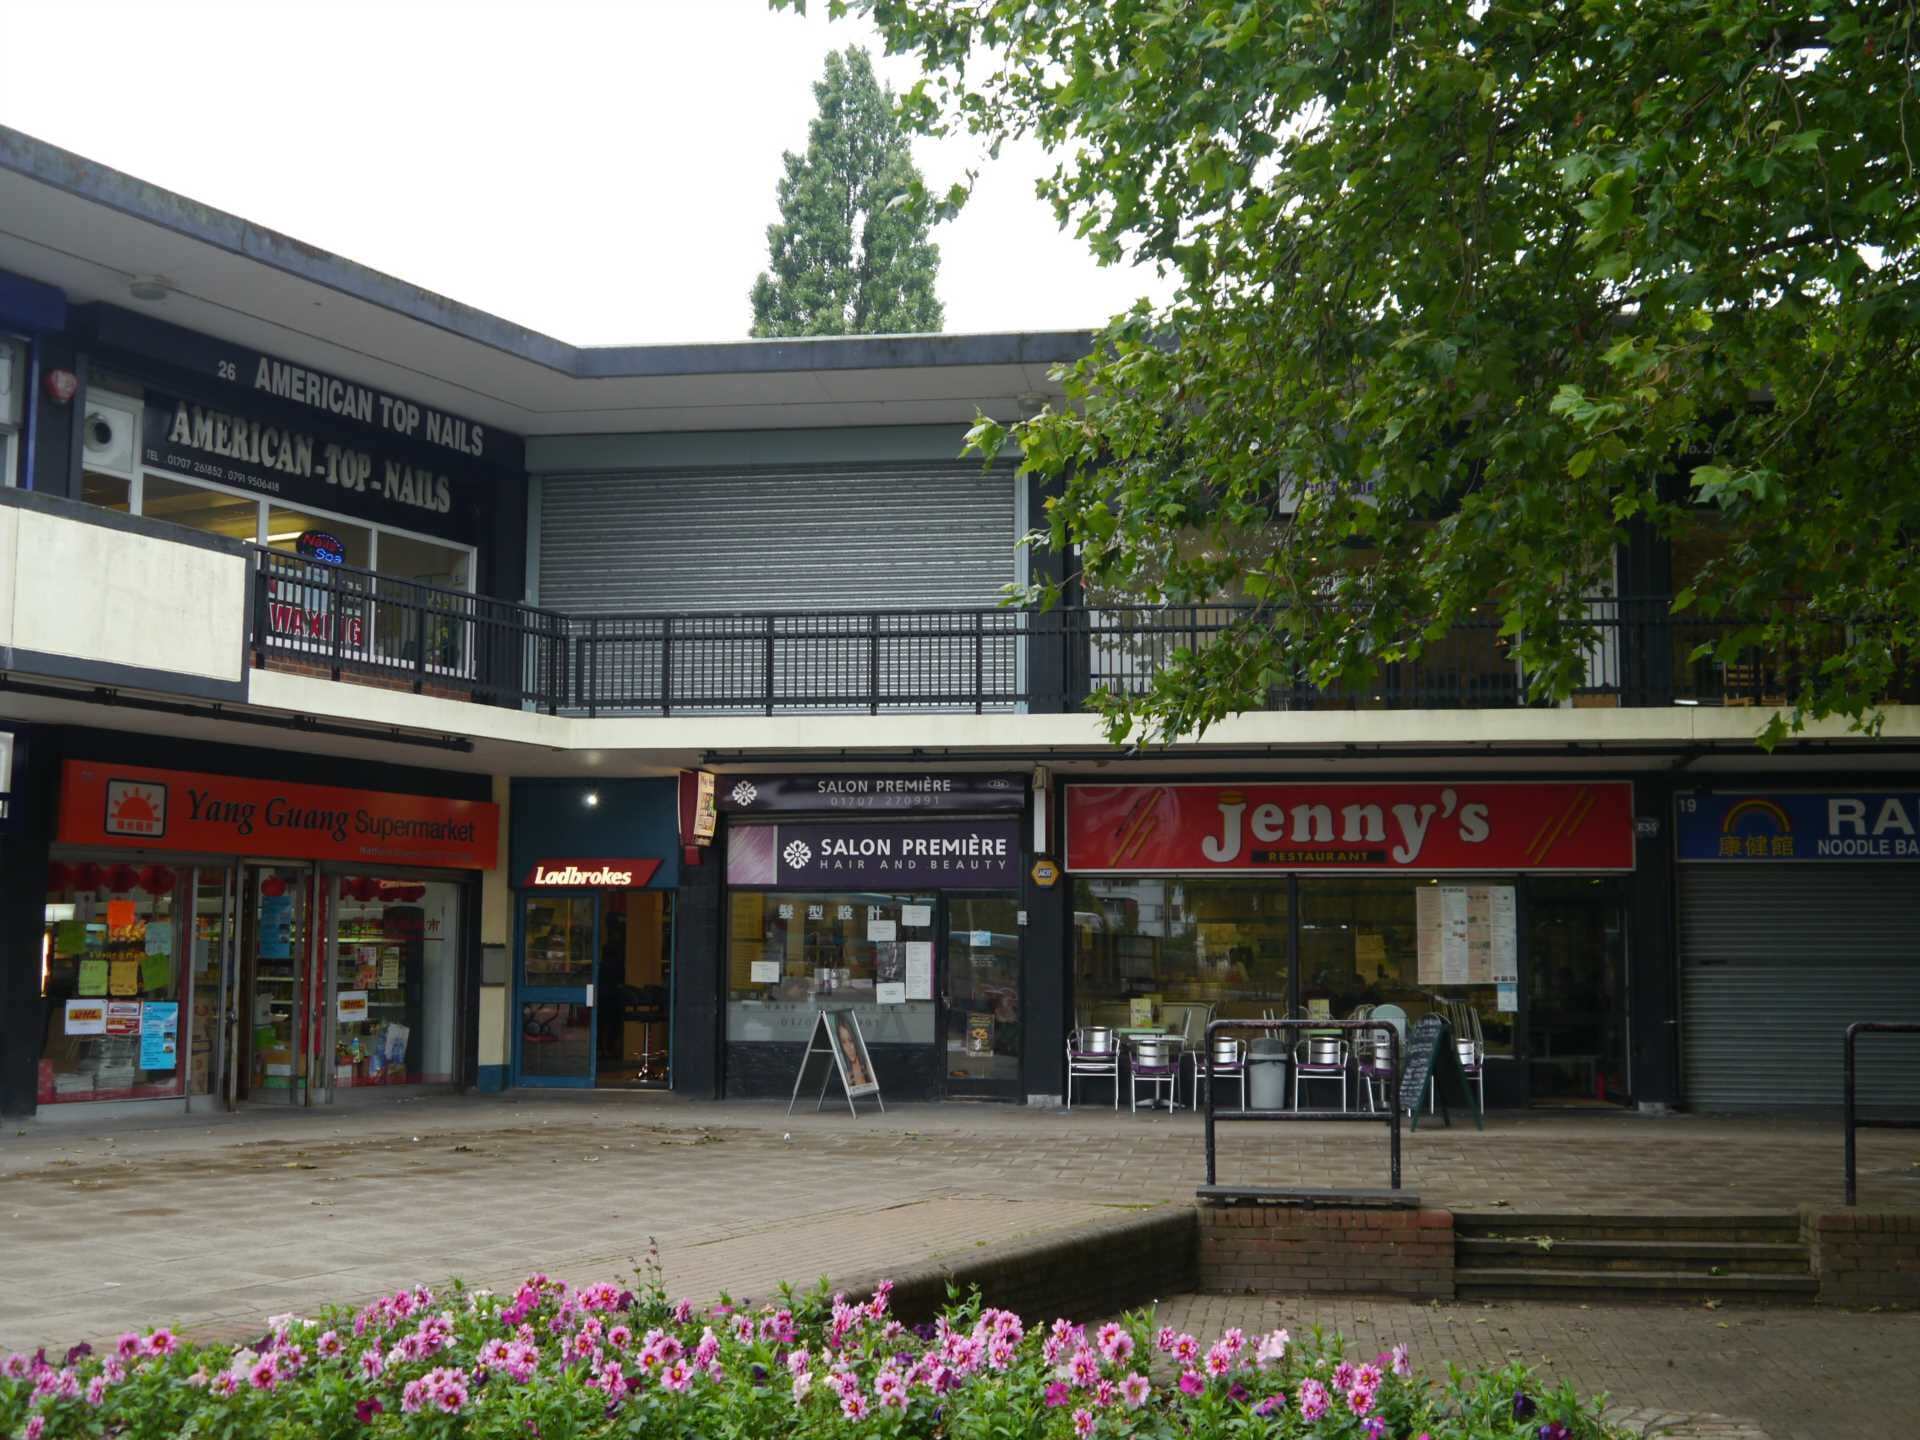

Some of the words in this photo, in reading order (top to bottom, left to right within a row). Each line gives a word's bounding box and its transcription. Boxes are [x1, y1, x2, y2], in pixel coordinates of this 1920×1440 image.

[217, 359, 236, 381] 26
[254, 356, 373, 424] AMERICAN
[379, 395, 420, 436] TOP
[426, 410, 485, 457] NAILS
[146, 448, 160, 462] TEL
[167, 452, 192, 469] 01707
[817, 780, 868, 793] SALON
[876, 776, 952, 793] PREMIÈRE
[830, 796, 874, 806] 01707
[885, 795, 941, 806] 270991
[1679, 799, 1696, 813] 19
[186, 788, 257, 835] Yang
[265, 796, 350, 842] Guang
[355, 809, 476, 843] Supermarket
[1828, 798, 1920, 836] RA
[1200, 788, 1491, 864] Jenny's
[820, 837, 891, 856] SALON
[902, 834, 1008, 856] PREMIÈRE
[1817, 839, 1890, 856] NOODLE
[820, 859, 866, 870] HAIR
[880, 859, 917, 870] AND
[930, 859, 1008, 870] BEAUTY
[1267, 851, 1370, 862] RESTAURANT
[534, 866, 633, 886] Ladbrokes
